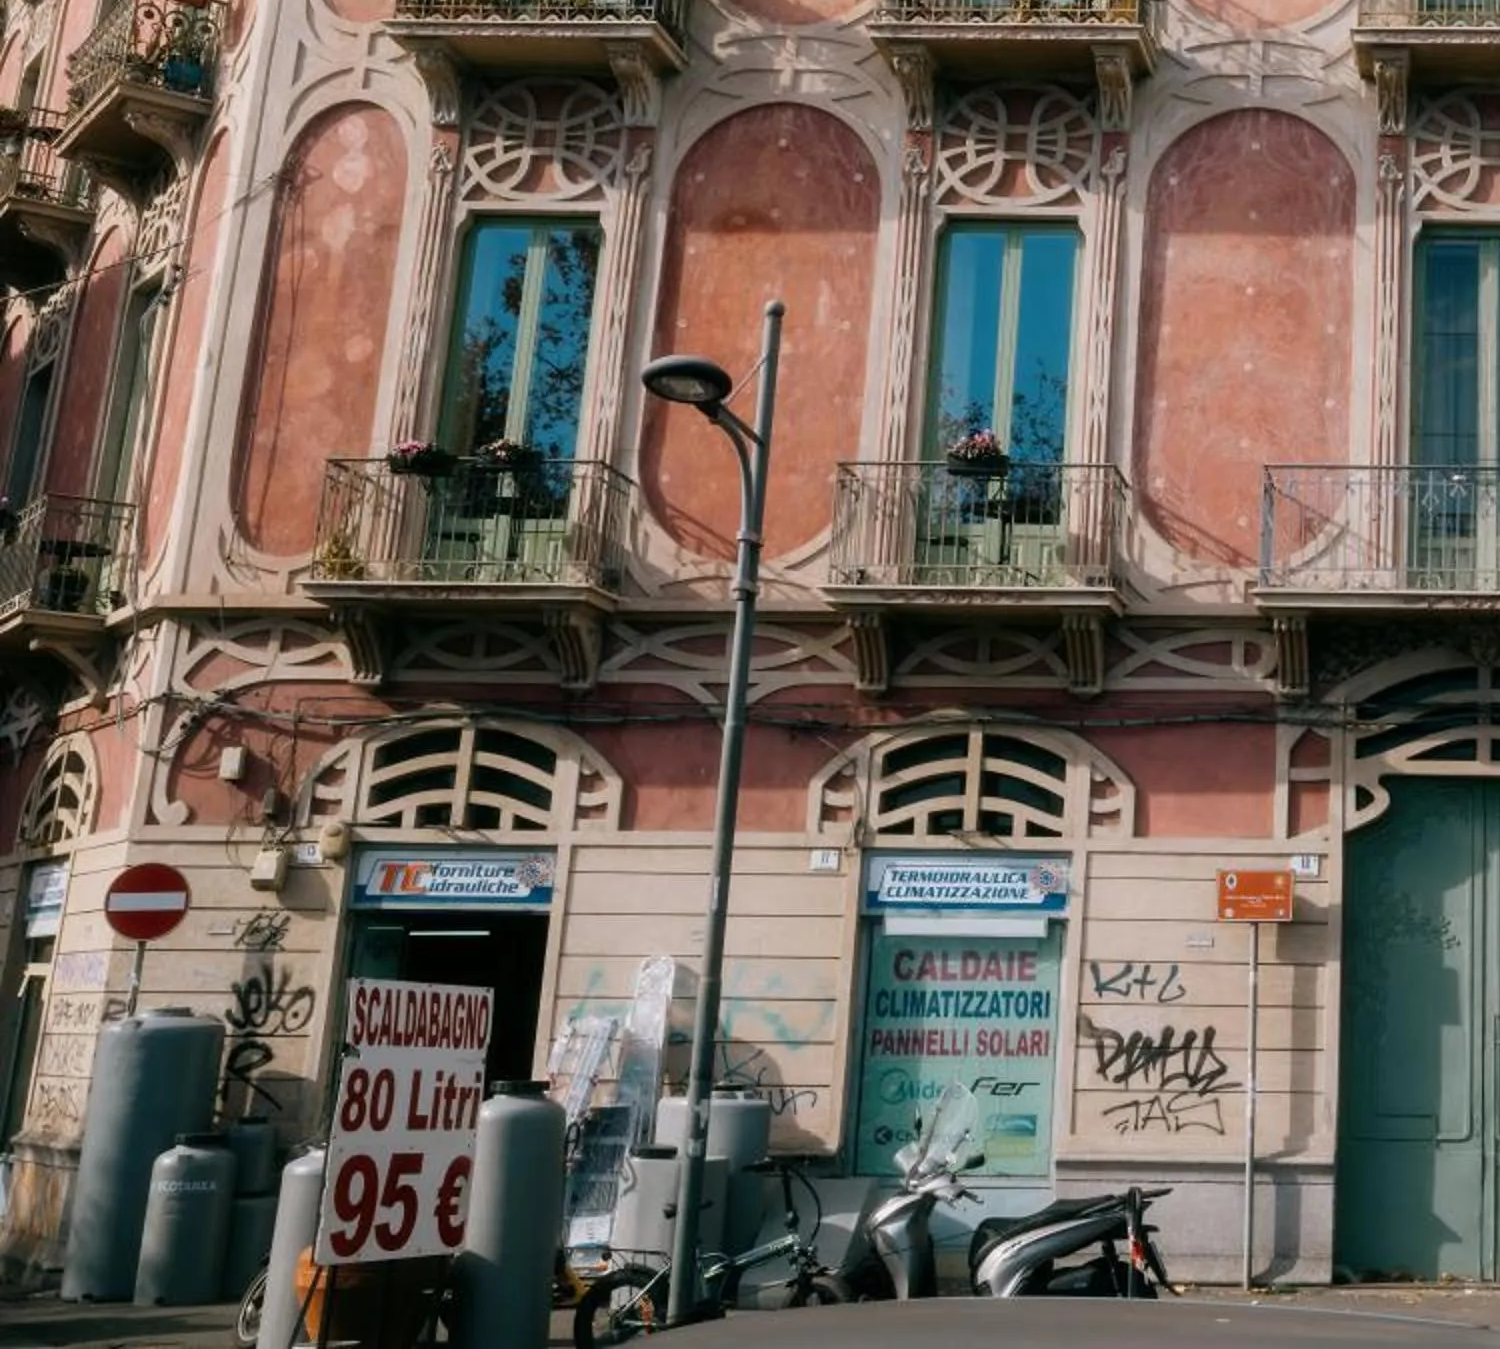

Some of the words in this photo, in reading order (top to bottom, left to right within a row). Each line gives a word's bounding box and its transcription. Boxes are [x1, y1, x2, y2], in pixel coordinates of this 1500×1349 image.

[379, 862, 431, 894] TC
[430, 862, 516, 878] forniture
[890, 870, 1028, 884] TERMOIDRAULICA
[428, 879, 520, 895] idrauliche
[886, 886, 1029, 900] CLIMATIZZAZIONE
[893, 949, 1038, 982] CALDAIE
[352, 986, 490, 1050] SCALDABAGNO
[875, 989, 1051, 1019] CLIMATIZZATORI
[871, 1028, 970, 1057] PANNELLI
[976, 1028, 1050, 1057] SOLARI
[340, 1068, 396, 1132] 80
[406, 1069, 483, 1131] Litri
[971, 1076, 1041, 1097] Fer
[330, 1153, 424, 1258] 95
[434, 1154, 474, 1249] €
